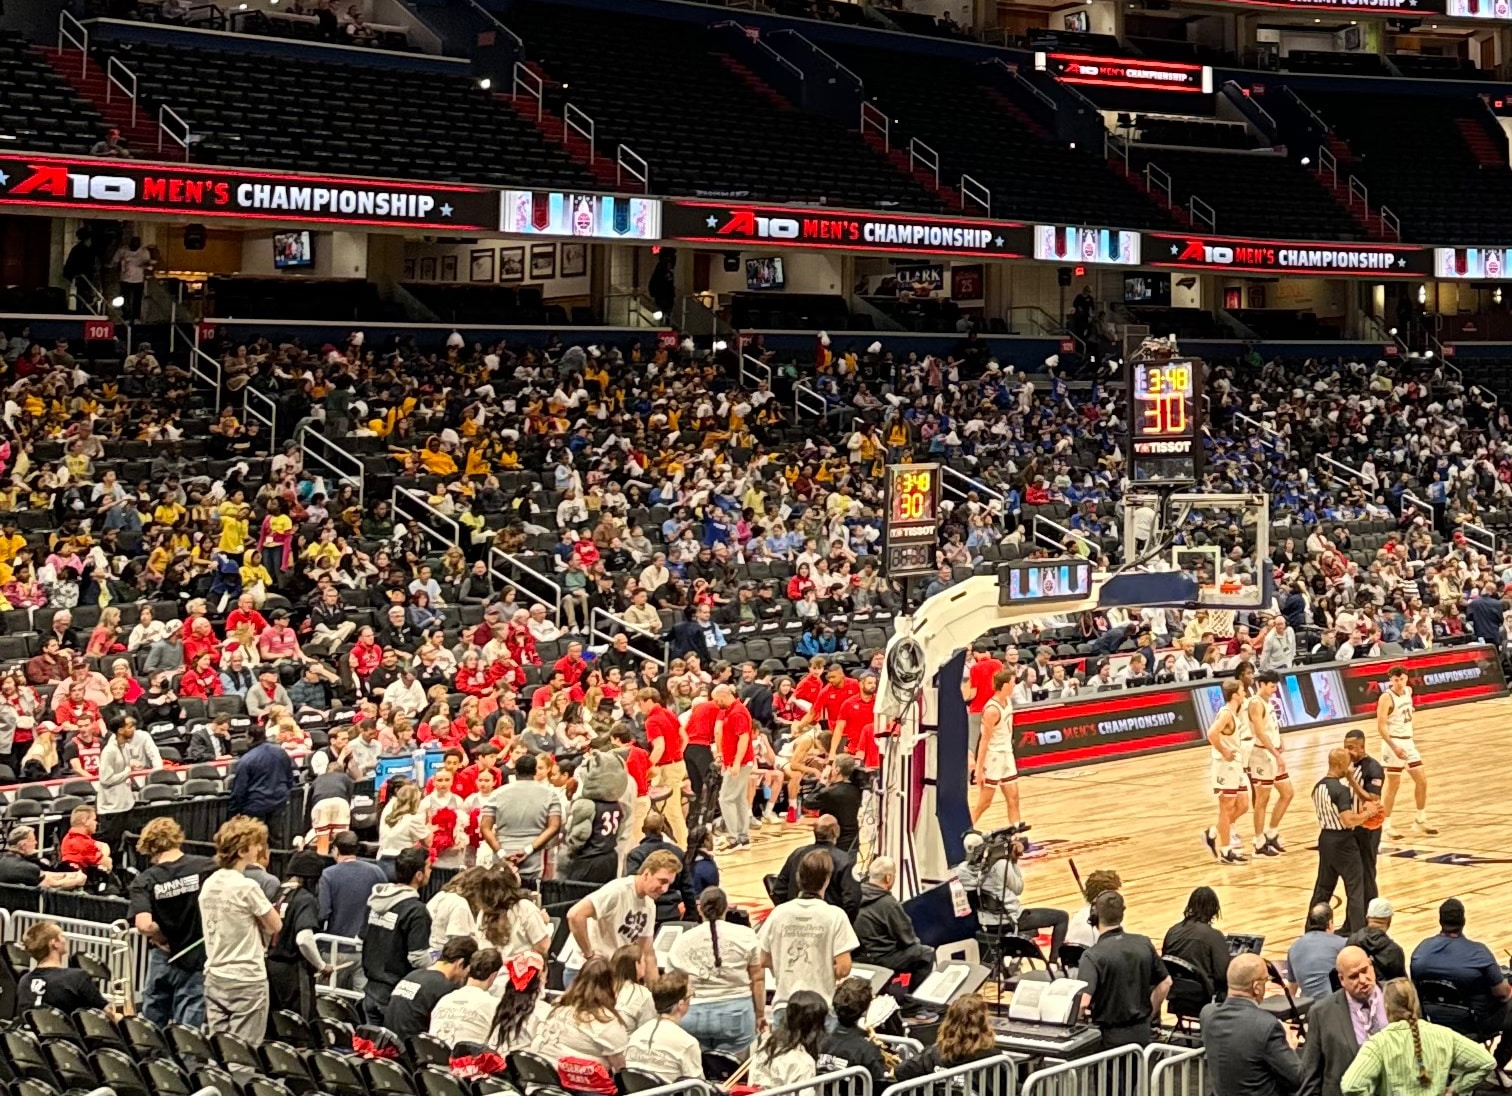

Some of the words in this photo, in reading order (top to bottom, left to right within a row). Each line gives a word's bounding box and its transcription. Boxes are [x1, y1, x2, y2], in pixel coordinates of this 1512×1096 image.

[7, 166, 136, 202] A10
[142, 176, 230, 204] MEN'S
[237, 183, 435, 219] CHAMPIONSHIP
[897, 268, 942, 284] CLARK
[89, 325, 109, 339] 101
[1149, 367, 1189, 392] 3:48
[1143, 392, 1186, 433] 30
[1150, 441, 1192, 453] TISSOT
[900, 493, 923, 518] 30
[1063, 724, 1097, 741] MEN'S
[1098, 712, 1176, 735] CHAMPIONSHIP
